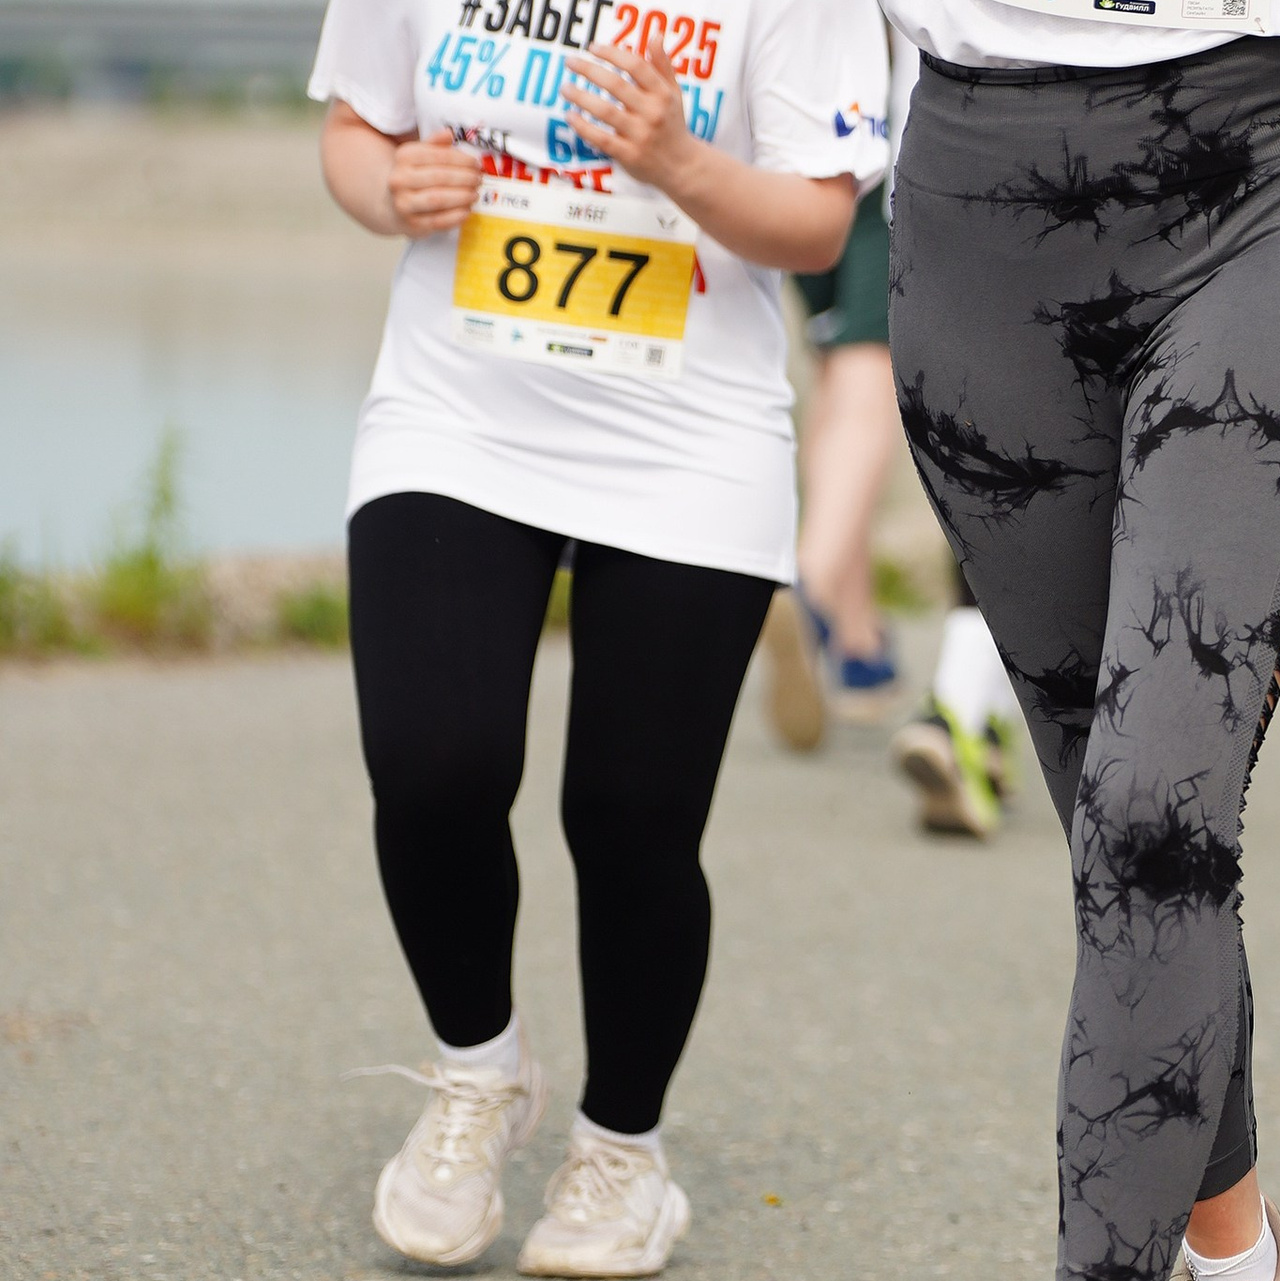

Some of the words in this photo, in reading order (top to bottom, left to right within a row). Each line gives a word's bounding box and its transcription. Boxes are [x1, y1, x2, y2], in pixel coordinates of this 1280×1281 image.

[427, 33, 510, 97] 45%
[612, 3, 721, 80] 2025
[497, 235, 650, 318] 877
